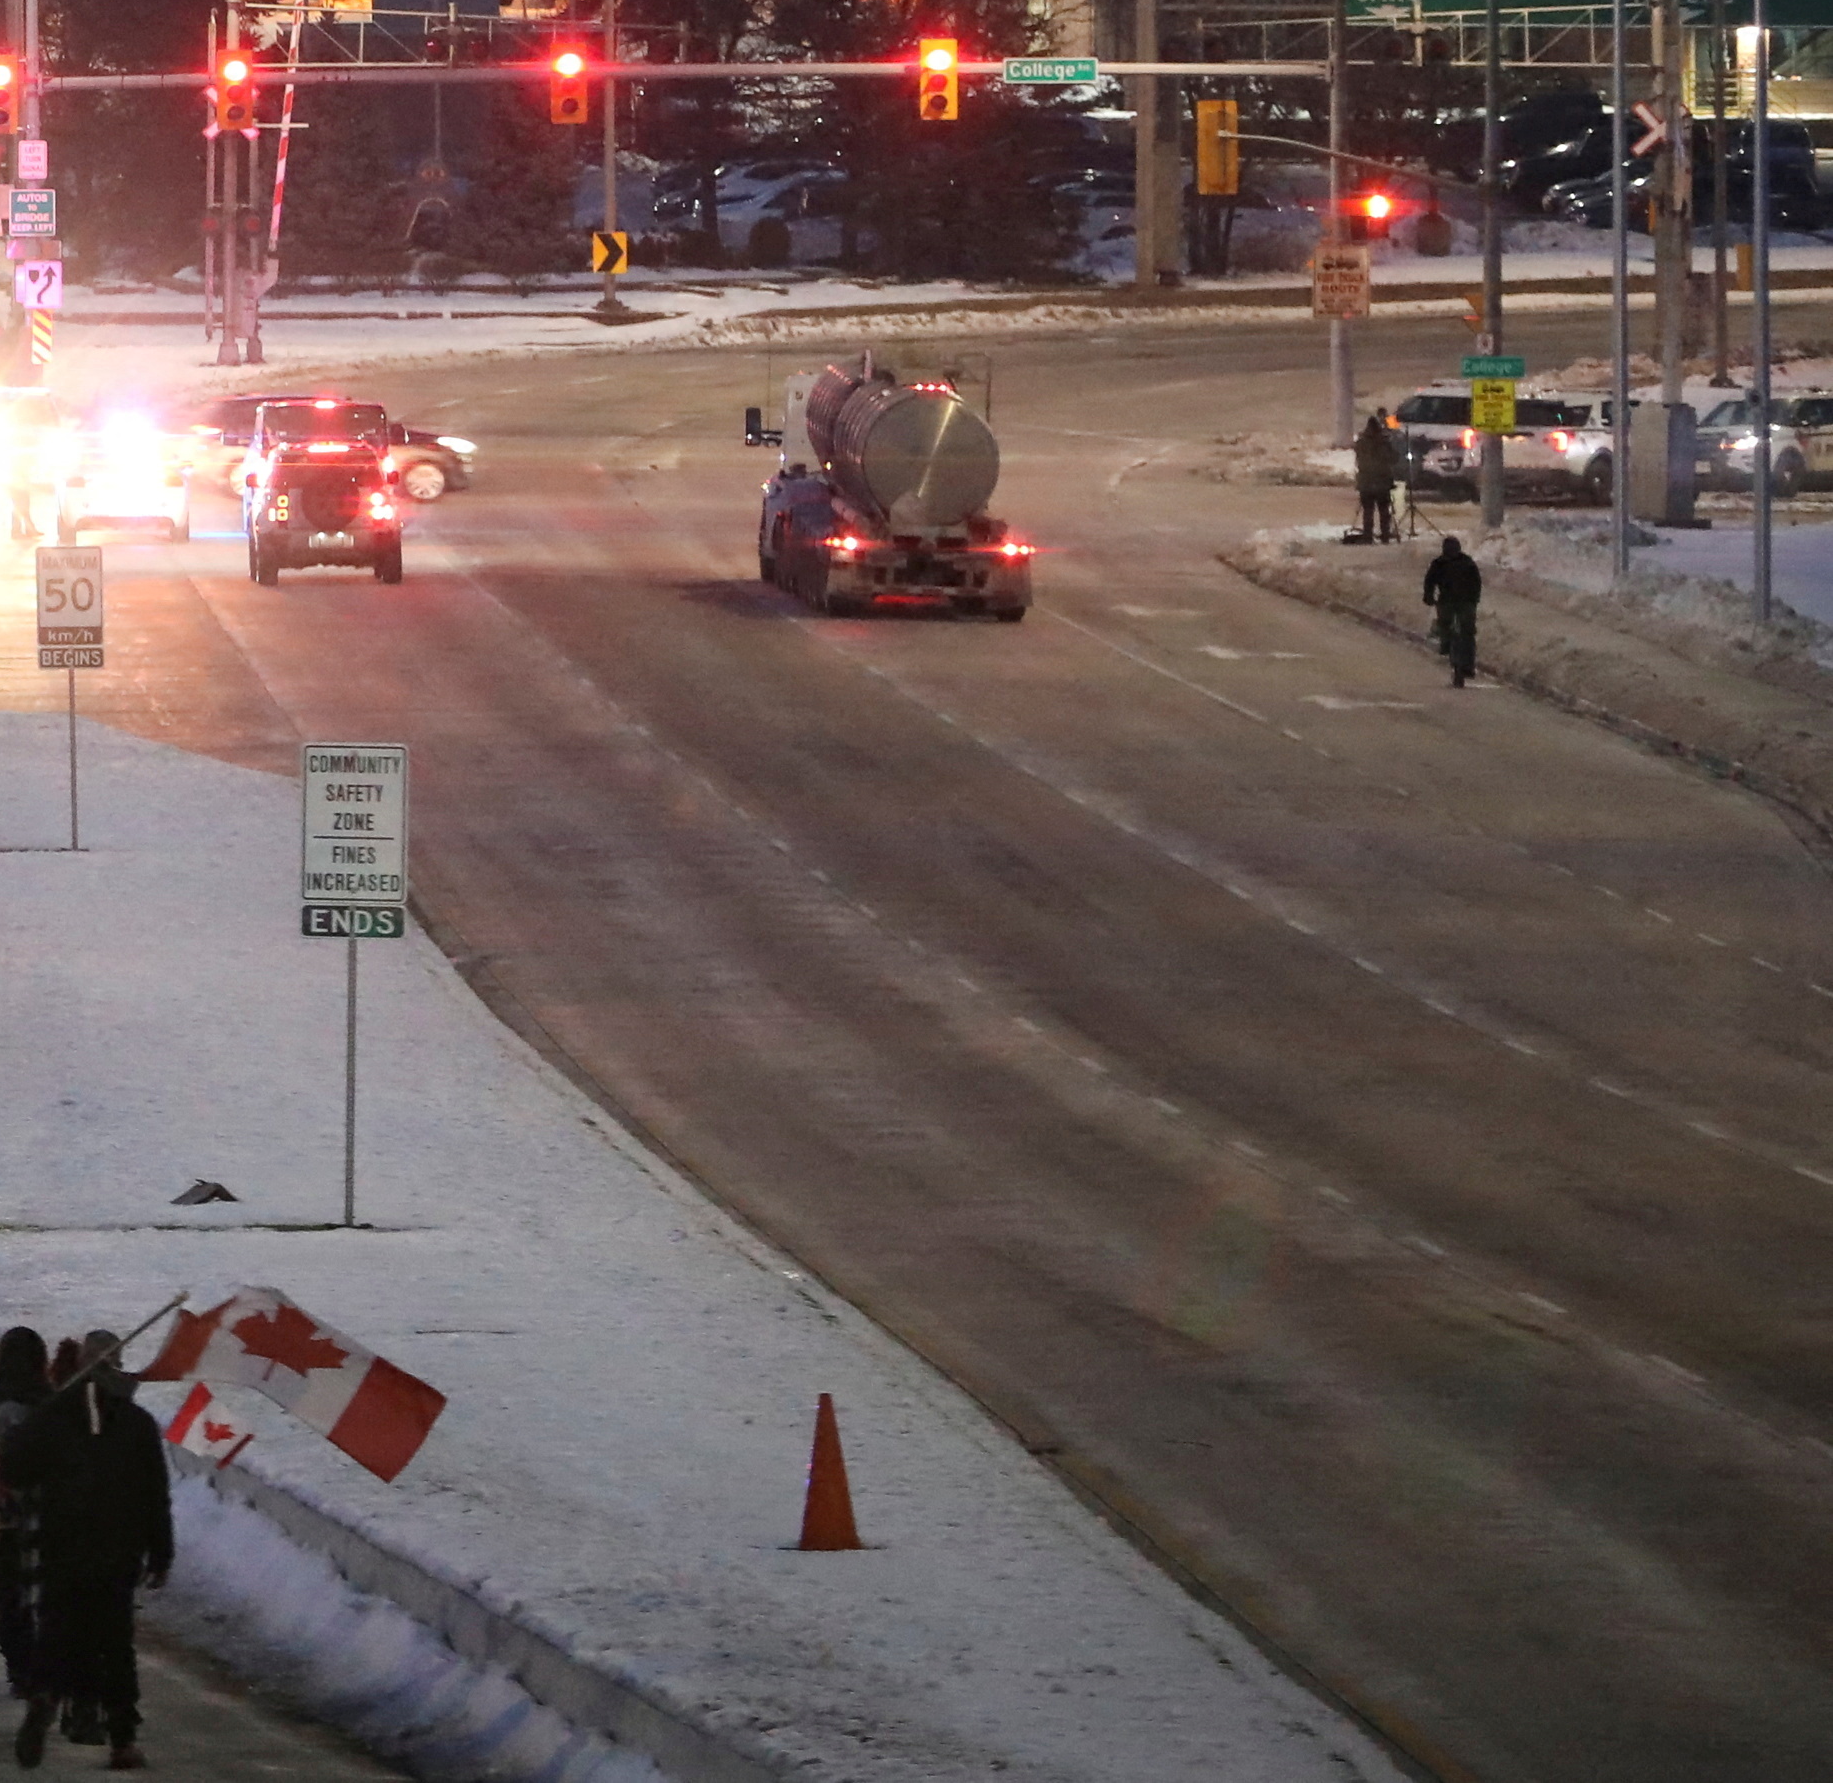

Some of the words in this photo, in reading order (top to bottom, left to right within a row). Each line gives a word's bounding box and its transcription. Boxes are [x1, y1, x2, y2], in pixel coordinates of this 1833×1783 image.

[1009, 61, 1076, 81] College
[17, 193, 49, 203] AUTOS
[15, 212, 50, 222] BRIDGE
[27, 204, 38, 212] TO
[12, 223, 33, 232] KEEP
[34, 223, 54, 232] LEFT
[44, 577, 95, 613] 50
[48, 628, 94, 643] km/h
[41, 649, 101, 667] BEGINS
[309, 754, 401, 774] COMMUNITY
[325, 783, 384, 802] SAFETY
[333, 812, 375, 831] ZONE
[332, 845, 377, 864] FINES
[306, 872, 401, 892] INCREASED
[310, 908, 396, 935] ENDS
